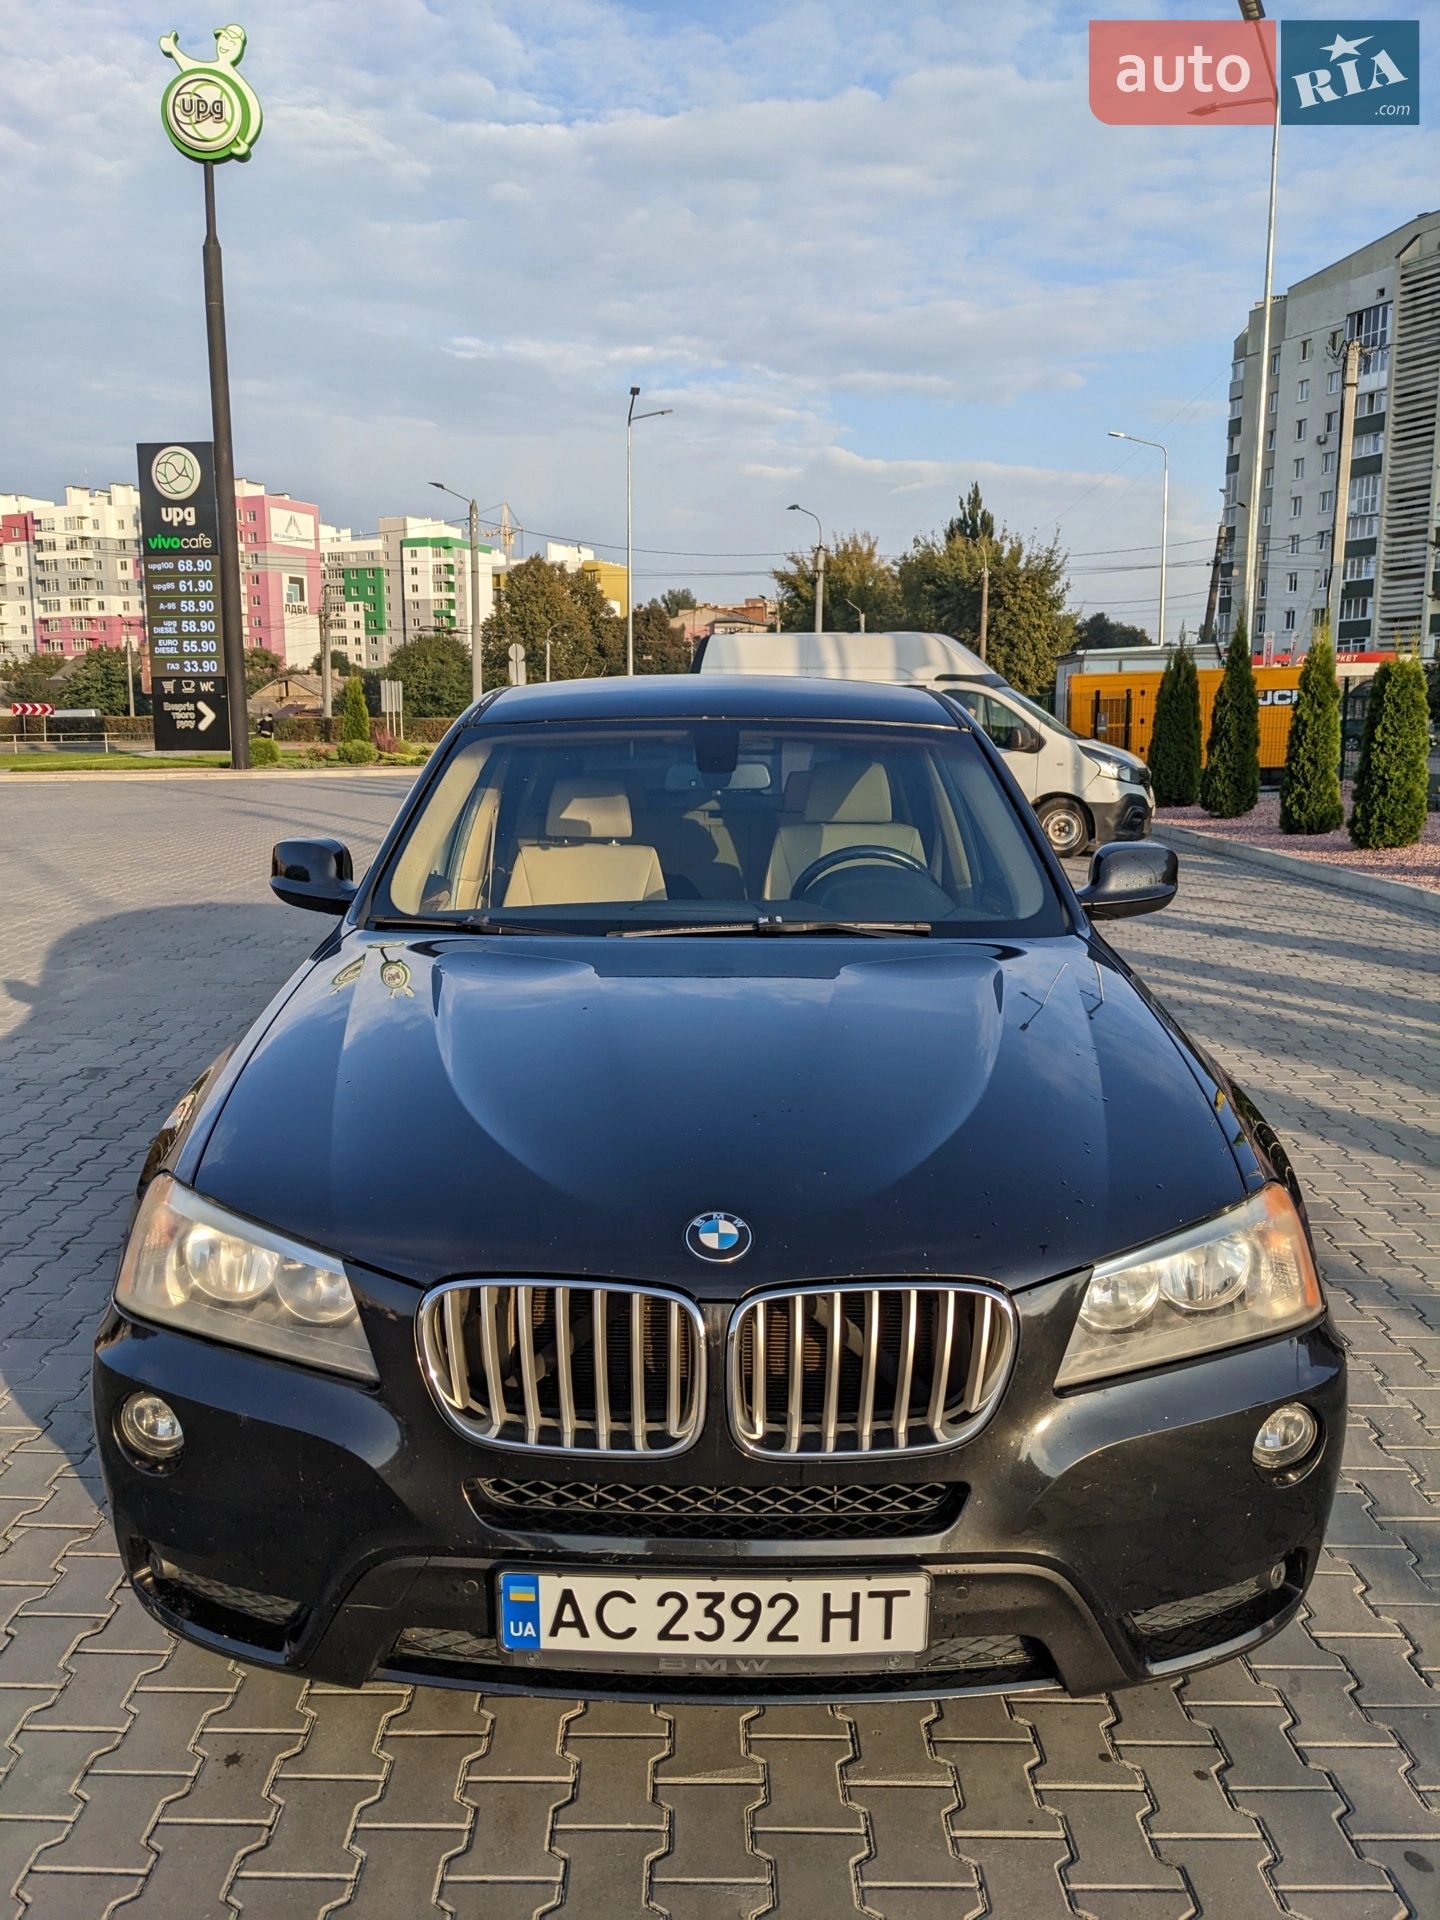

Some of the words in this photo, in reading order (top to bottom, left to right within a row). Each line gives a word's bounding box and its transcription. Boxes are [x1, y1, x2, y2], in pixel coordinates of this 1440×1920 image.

[181, 98, 225, 123] upg
[161, 507, 196, 527] upg
[148, 533, 212, 549] vivocafe
[148, 561, 174, 571] upg100
[178, 560, 212, 572] 68.90
[153, 582, 175, 591] upg95
[179, 580, 213, 592] 61.90
[180, 600, 214, 612] 58.90
[284, 603, 308, 616] ЛДБК
[181, 620, 215, 633] 58.90
[182, 640, 216, 653] 55.90
[183, 660, 217, 673] 33.90
[199, 681, 215, 692] WC
[693, 1213, 746, 1228] BMW
[549, 1588, 637, 1640] AC
[656, 1590, 799, 1643] 2392
[821, 1590, 911, 1643] HT
[510, 1621, 536, 1638] UA
[658, 1658, 770, 1672] BMW
